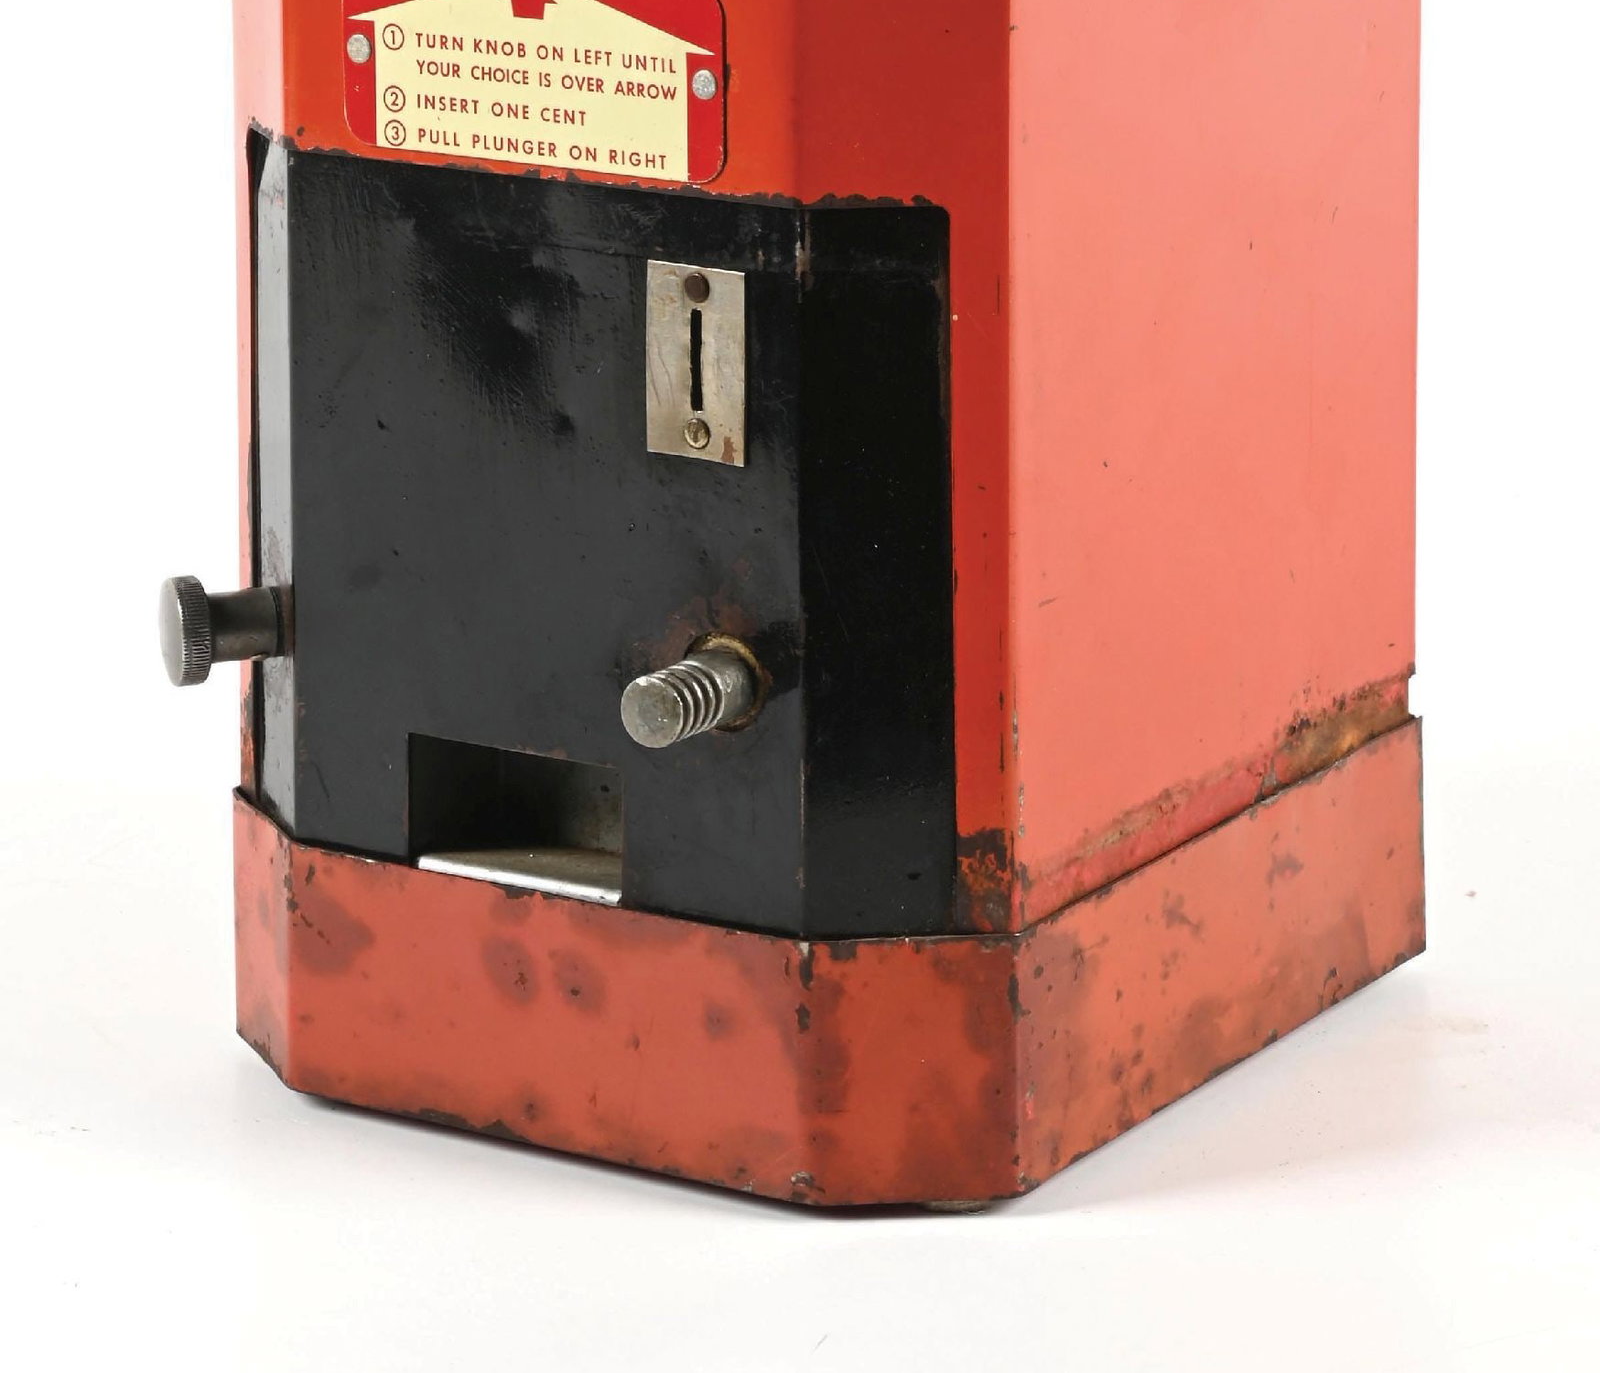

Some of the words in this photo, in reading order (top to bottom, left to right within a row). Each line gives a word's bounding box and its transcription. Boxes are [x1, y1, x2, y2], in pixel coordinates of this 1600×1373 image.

[416, 32, 464, 52] TURN
[473, 38, 527, 59] KNOB
[536, 44, 565, 62] ON
[574, 48, 613, 68] LEFT
[622, 53, 677, 74] UNTIL
[416, 59, 461, 79] YOUR
[470, 65, 530, 85] CHOICE
[539, 71, 552, 87] IS
[561, 74, 605, 94] OVER
[614, 81, 678, 101] ARROW
[416, 93, 480, 115] INSERT
[491, 102, 530, 120] ONE
[540, 107, 587, 127] CENT
[417, 128, 461, 147] PULL
[471, 133, 558, 158] PLUNGER
[569, 145, 598, 163] ON
[609, 149, 668, 171] RIGHT
